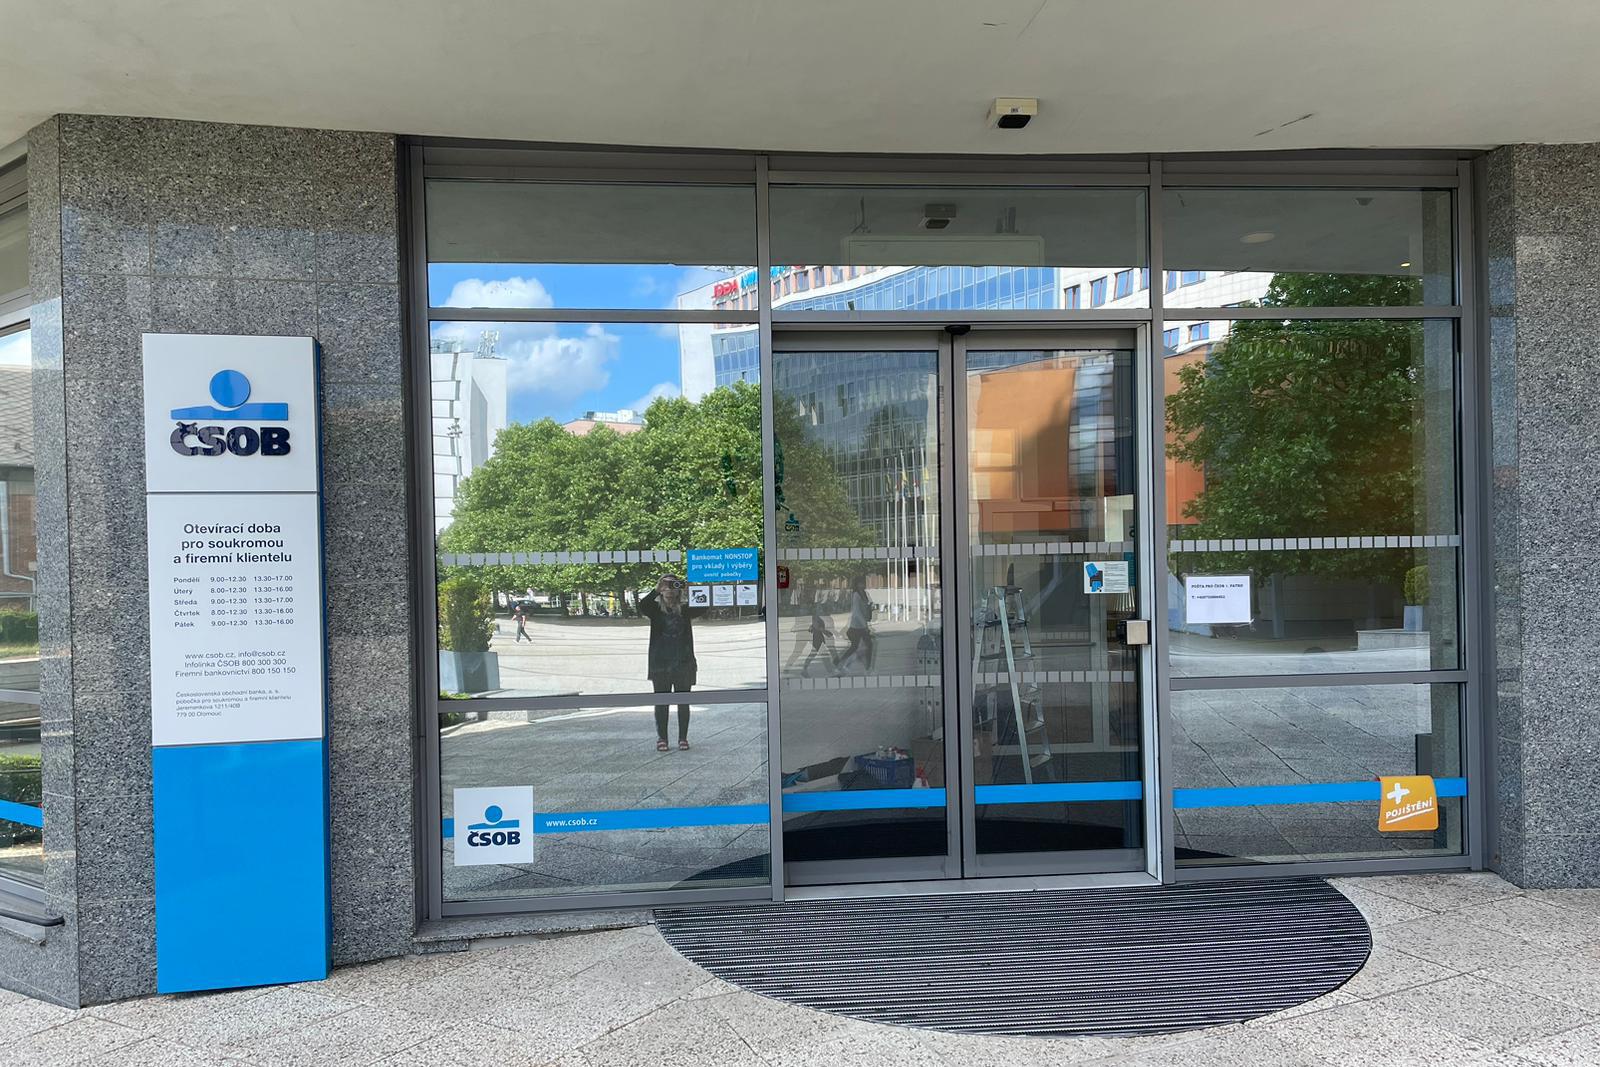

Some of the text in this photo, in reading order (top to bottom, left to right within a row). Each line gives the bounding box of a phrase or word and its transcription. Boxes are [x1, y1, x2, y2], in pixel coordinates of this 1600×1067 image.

[170, 421, 291, 456] ČSOB
[183, 523, 281, 534] Otevírací doba
[181, 538, 283, 550] pro soukromou
[173, 552, 292, 564] a firemní klientelu
[731, 562, 753, 570] výběry
[238, 650, 286, 658] info@csob.cz
[184, 661, 215, 669] Infolinka
[217, 659, 240, 667] ČSOB
[175, 670, 202, 678] Firemní
[204, 668, 250, 677] bankovnictví
[283, 666, 296, 674] 150
[1385, 796, 1433, 819] POJIŠTĚNÍ
[545, 817, 598, 827] www.csob.cz
[467, 830, 521, 847] ČSOB
